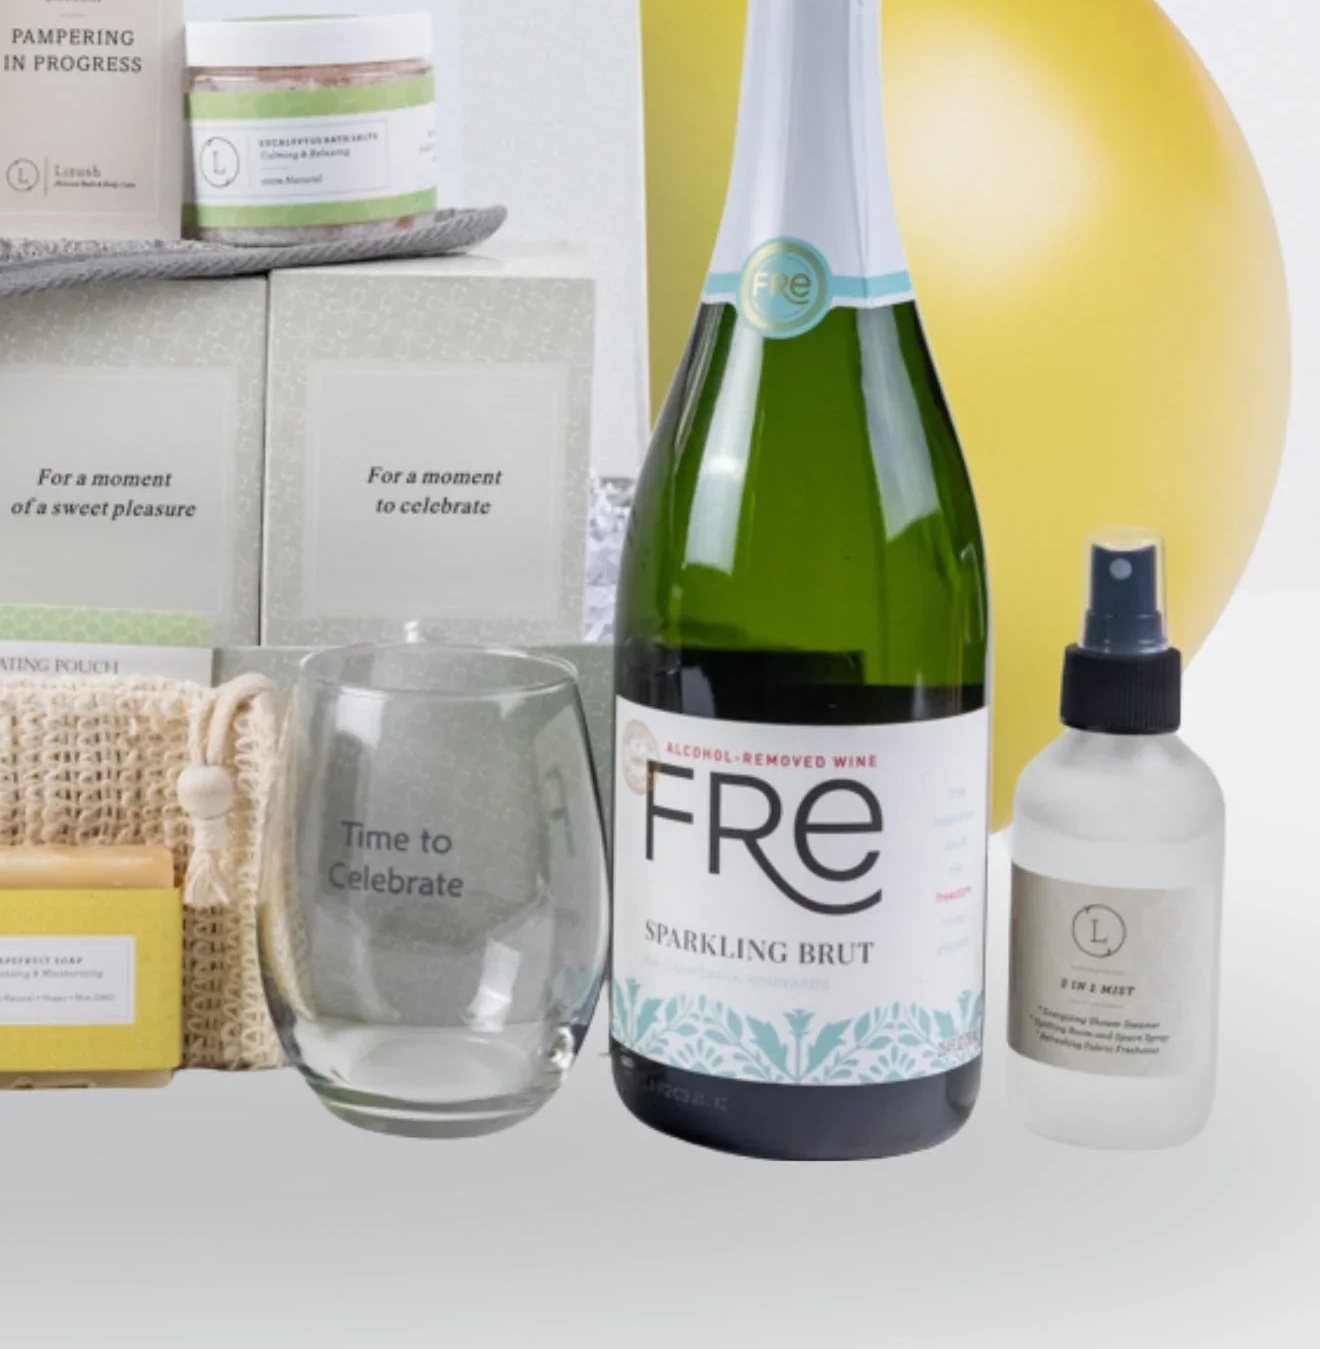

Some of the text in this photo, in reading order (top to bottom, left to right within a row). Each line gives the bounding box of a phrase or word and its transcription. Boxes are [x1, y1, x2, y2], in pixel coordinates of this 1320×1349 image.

[12, 28, 136, 46] PAMPERING
[3, 54, 143, 73] IN PROGRESS
[37, 468, 172, 488] For a moment
[367, 466, 503, 485] For a moment
[10, 497, 197, 521] of a sweet pleasure
[375, 496, 491, 515] to celebrate
[54, 658, 120, 675] POUCH
[666, 741, 877, 768] ALCOHOL-REMOVED WINE
[340, 820, 452, 854] Time to
[328, 861, 464, 898] Celebrate
[1091, 919, 1108, 943] L
[645, 919, 875, 966] SPARKLING BRUT
[54, 956, 82, 965] SOAP
[1071, 980, 1086, 991] IN
[1100, 985, 1135, 996] MIST
